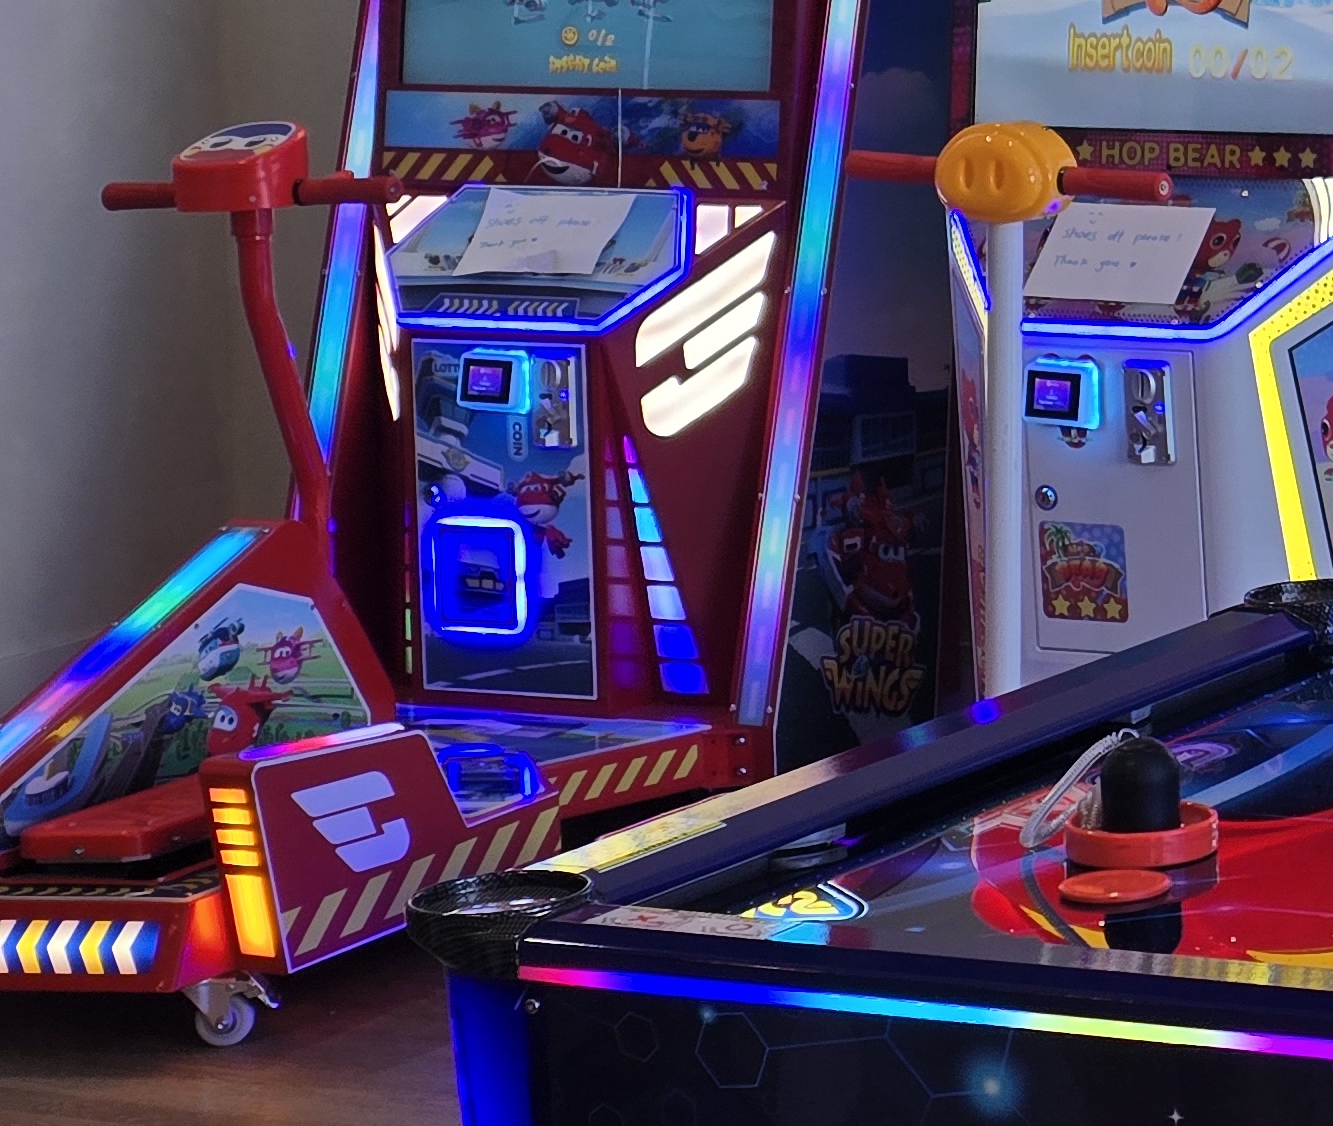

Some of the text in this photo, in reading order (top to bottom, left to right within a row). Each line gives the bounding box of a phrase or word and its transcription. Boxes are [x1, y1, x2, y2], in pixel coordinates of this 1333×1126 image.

[1068, 22, 1132, 73] Insert
[1132, 28, 1173, 74] coin
[1101, 142, 1242, 170] HOP BEAR
[512, 421, 523, 457] COIN
[839, 619, 914, 668] SUPER
